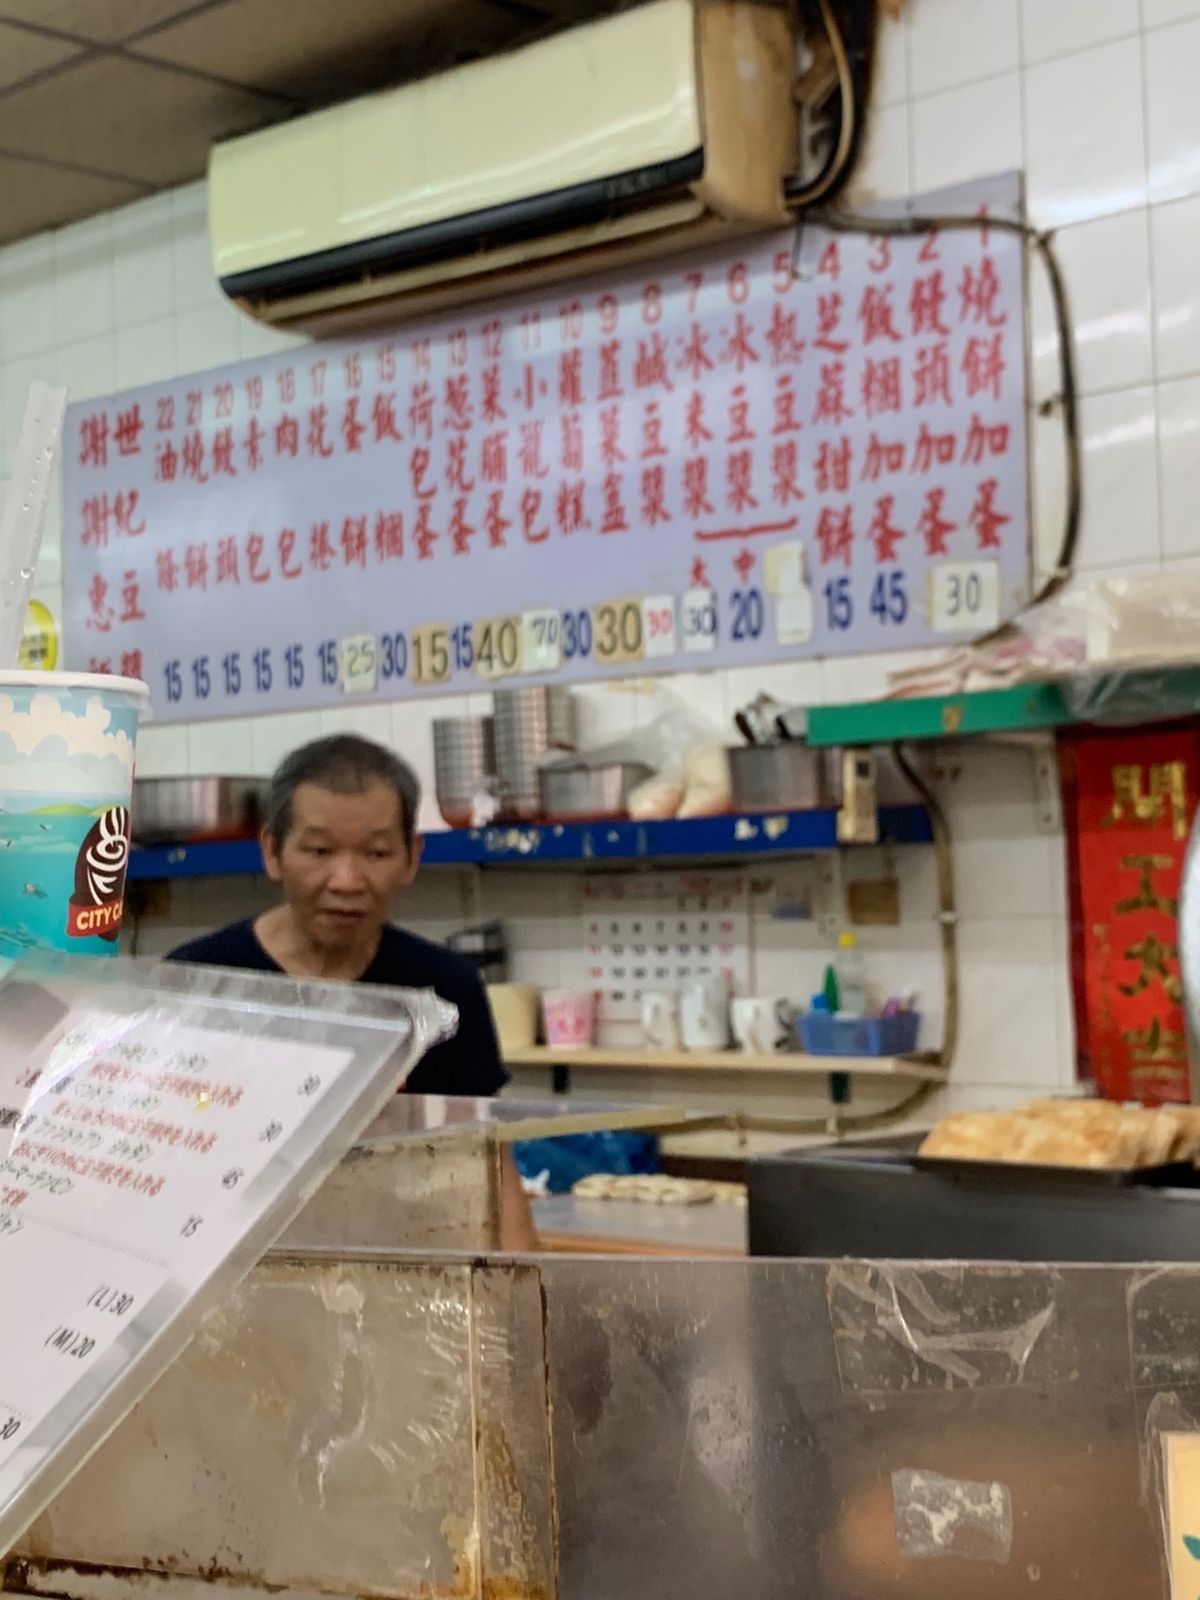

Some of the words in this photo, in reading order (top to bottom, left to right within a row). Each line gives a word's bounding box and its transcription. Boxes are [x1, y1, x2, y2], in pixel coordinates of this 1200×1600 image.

[772, 250, 794, 294] 5
[817, 238, 842, 281] 4
[642, 279, 663, 325] 8
[684, 270, 705, 312] 7
[727, 260, 749, 304] 6
[559, 300, 583, 340] 10
[597, 291, 618, 334] 9
[481, 319, 503, 359] 12
[156, 396, 175, 432] 22
[213, 381, 235, 419] 20
[690, 556, 713, 589] 大
[732, 548, 756, 585] 中
[729, 588, 764, 642] 20
[823, 574, 853, 632] 15
[868, 570, 908, 626] 45
[945, 569, 982, 618] 30
[452, 620, 474, 671] 15
[477, 618, 518, 671] 40
[533, 614, 557, 647] 70
[562, 607, 592, 658] 30
[598, 602, 642, 656] 30
[222, 652, 242, 695] 15
[253, 647, 272, 692] 15
[284, 642, 304, 689] 15
[317, 638, 338, 686] 15
[348, 639, 374, 678] 25
[381, 632, 407, 680] 30
[412, 628, 449, 681] 15
[164, 659, 182, 703] 15
[192, 655, 211, 700] 15
[76, 906, 112, 930] CITY
[179, 1213, 204, 1239] 15
[86, 1284, 135, 1317] (L)30
[44, 1325, 96, 1359] (M)20
[0, 1416, 22, 1441] 30
